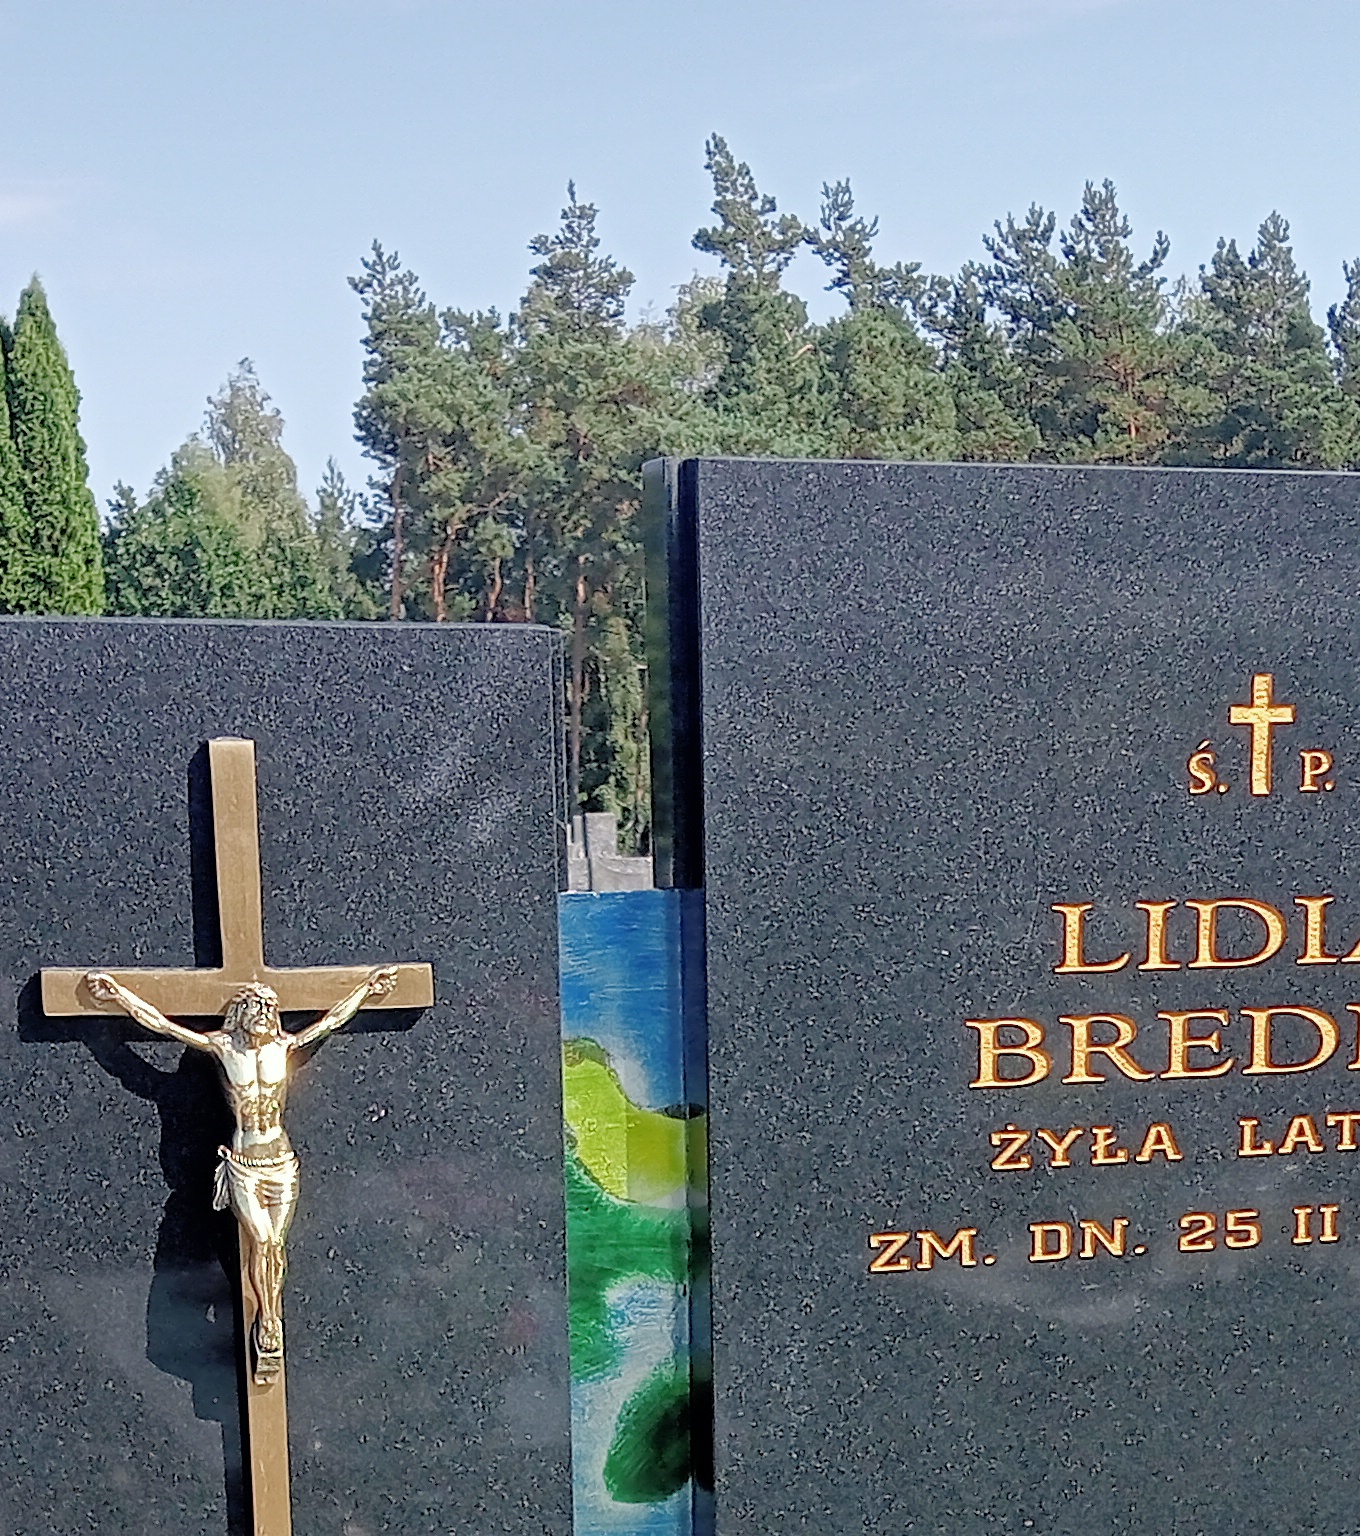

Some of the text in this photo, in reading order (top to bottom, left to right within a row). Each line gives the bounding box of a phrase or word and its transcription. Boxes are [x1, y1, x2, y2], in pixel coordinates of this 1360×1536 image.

[989, 1122, 1183, 1171] ŻYŁA
[868, 1227, 1000, 1275] ZM.
[1028, 1216, 1148, 1263] DN.
[1178, 1208, 1263, 1254] 25
[1291, 1203, 1340, 1245] II
